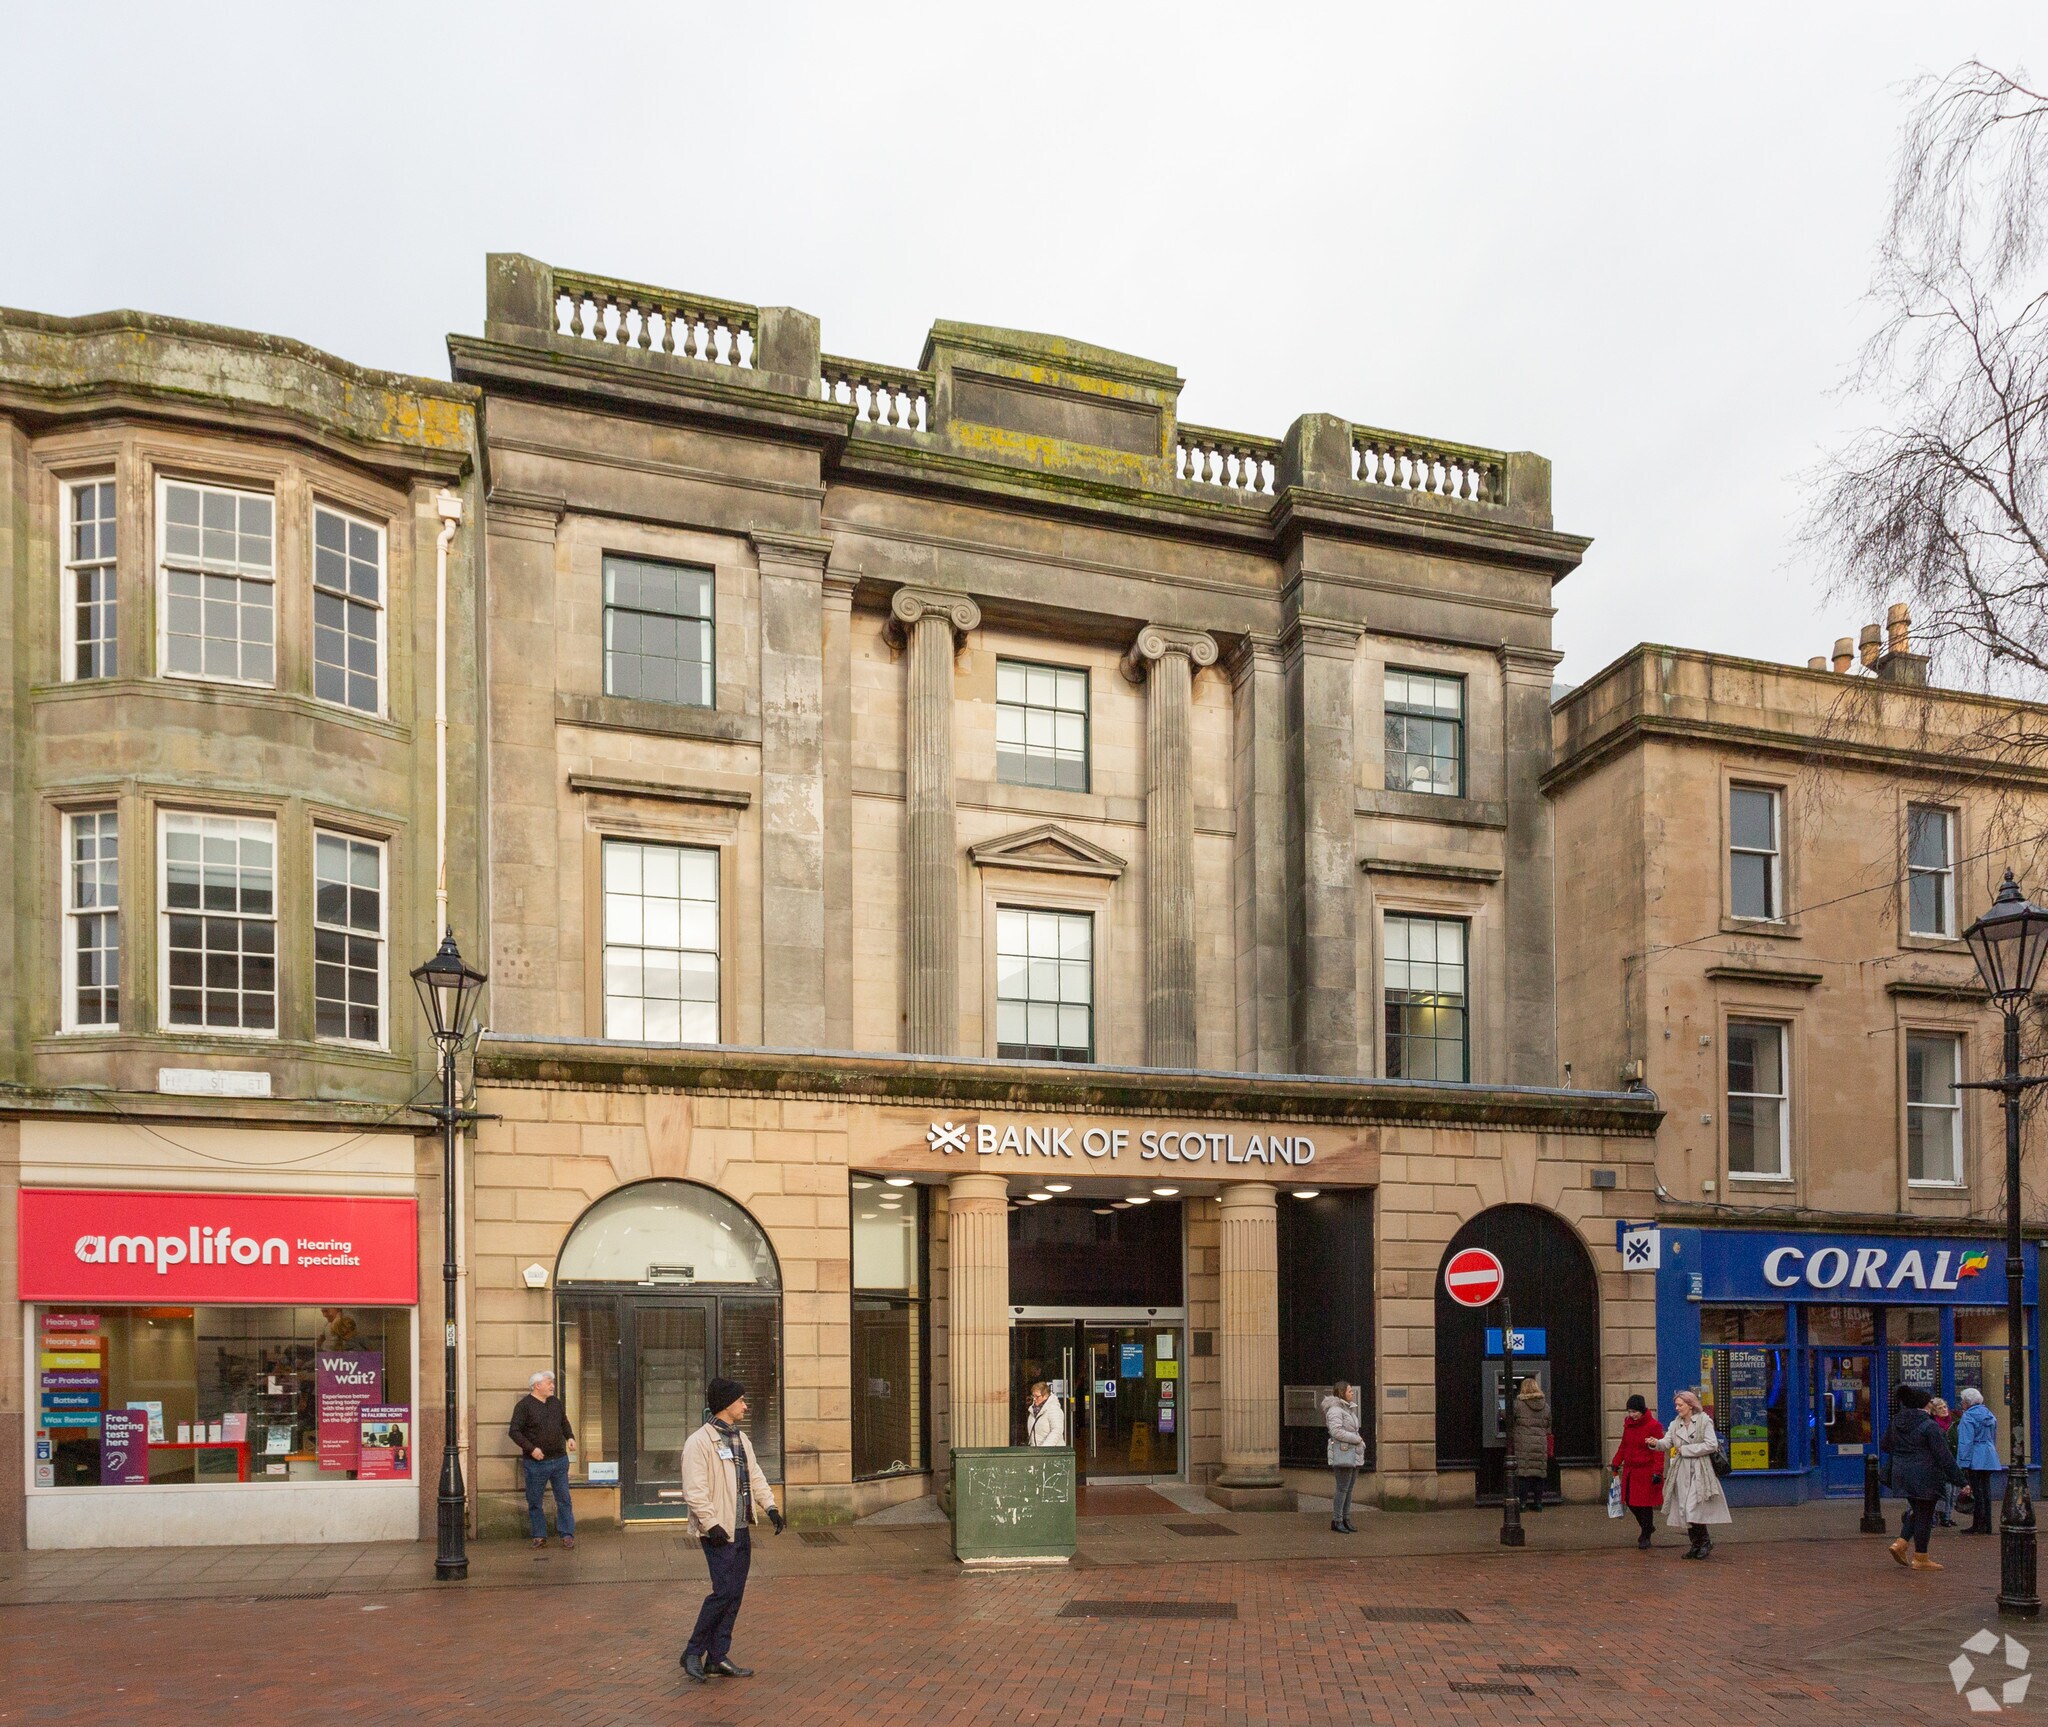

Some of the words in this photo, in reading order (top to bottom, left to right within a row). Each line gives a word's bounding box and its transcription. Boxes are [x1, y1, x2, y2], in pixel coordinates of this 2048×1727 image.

[977, 1124, 1074, 1157] BANK
[1082, 1127, 1130, 1158] OF
[1140, 1130, 1316, 1165] SCOTLAND
[74, 1226, 290, 1274] amplifon
[297, 1238, 352, 1253] Hearing
[297, 1254, 360, 1267] specialist
[1763, 1247, 1958, 1289] CORAL
[46, 1318, 78, 1327] Hearing
[80, 1318, 95, 1326] Test
[46, 1338, 77, 1346] Hearing
[322, 1358, 358, 1375] Why
[1902, 1354, 1929, 1367] BEST
[335, 1371, 376, 1385] wait?
[53, 1396, 89, 1404] Batteries
[106, 1422, 144, 1432] hearing
